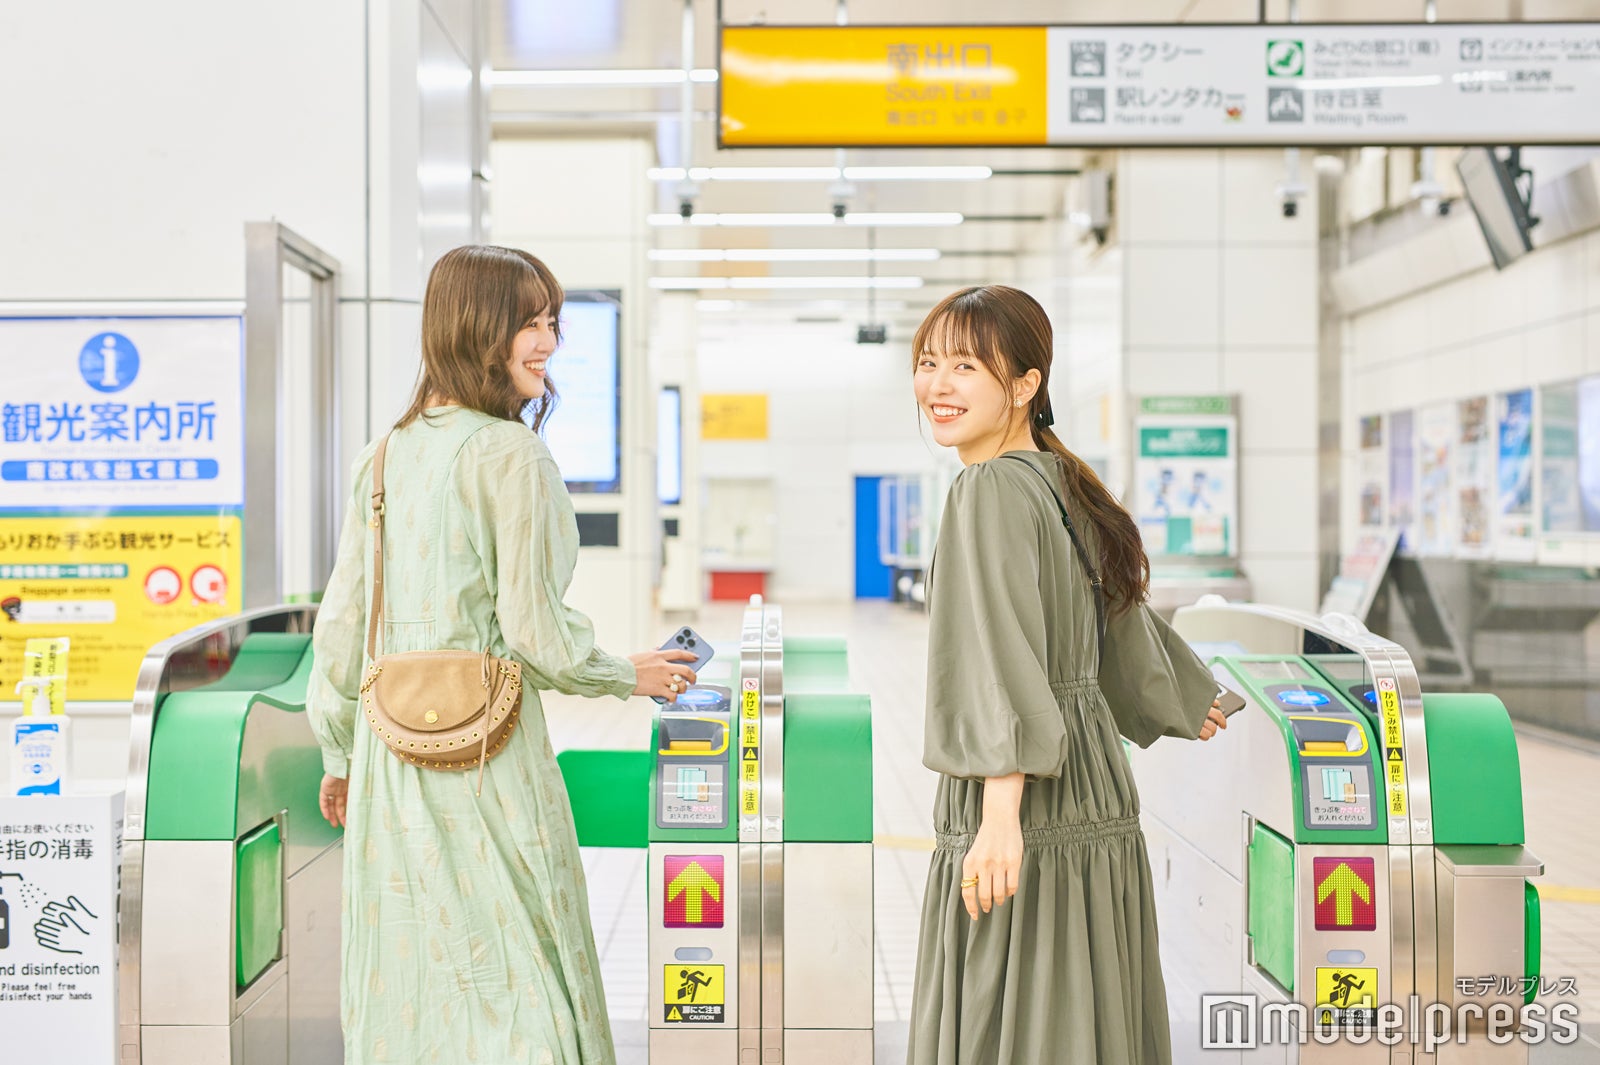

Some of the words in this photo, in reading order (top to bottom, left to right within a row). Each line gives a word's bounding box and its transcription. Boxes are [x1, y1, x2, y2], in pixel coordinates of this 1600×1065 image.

[885, 41, 992, 76] 南出口
[1115, 42, 1204, 62] タクシー
[885, 82, 946, 102] South
[954, 82, 992, 102] Exit
[1115, 86, 1246, 108] 駅レンタカー
[2, 402, 217, 443] 観光案内所
[1385, 692, 1398, 744] かけこみ禁止
[1391, 764, 1402, 812] 扉にご注意
[1314, 806, 1367, 814] きっぷをかさねて
[1317, 814, 1365, 822] お入れください
[0, 824, 94, 834] 由にお使いください
[0, 963, 15, 976] nd
[21, 962, 100, 976] disinfection
[1, 982, 29, 991] Please
[34, 982, 52, 991] feel
[57, 982, 76, 991] free
[0, 992, 41, 1001] disinfect
[46, 993, 64, 1002] your
[69, 992, 92, 1000] hands
[682, 1005, 721, 1014] 扉にご注意
